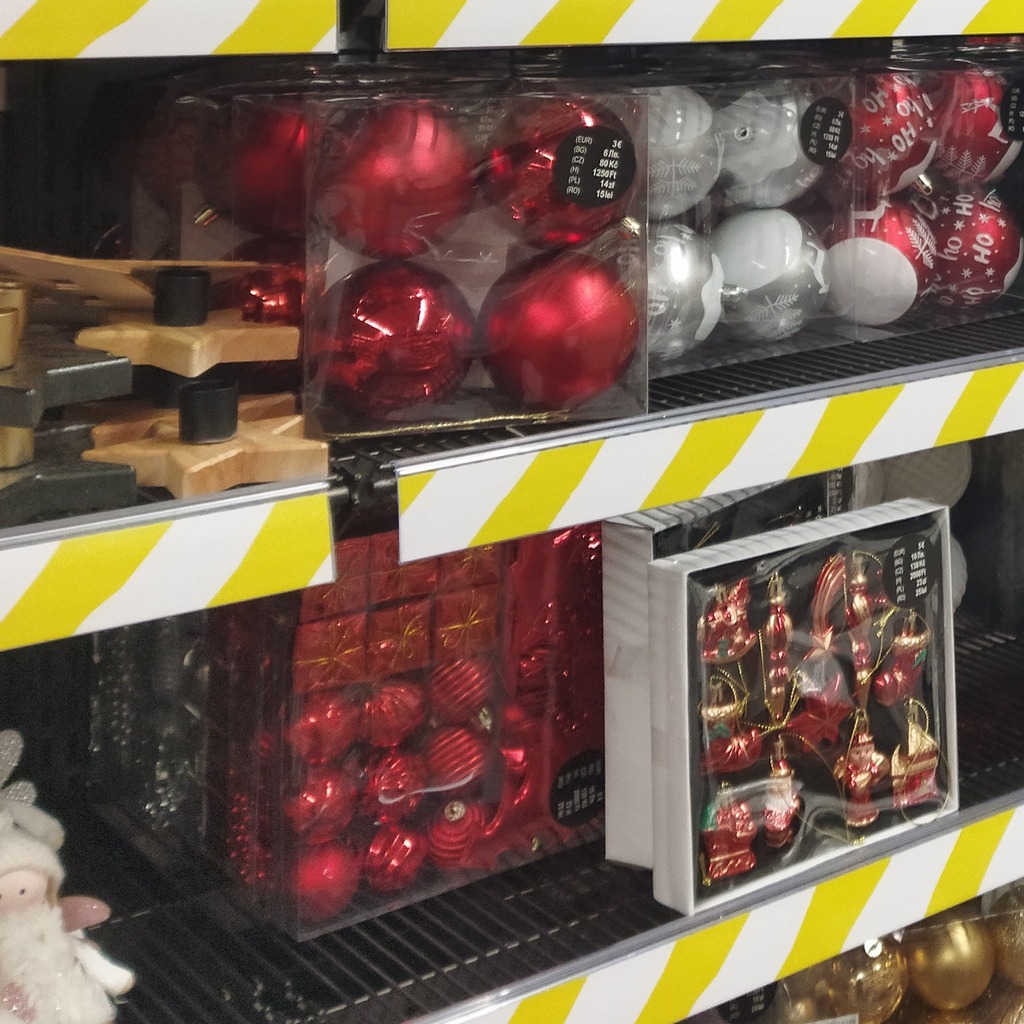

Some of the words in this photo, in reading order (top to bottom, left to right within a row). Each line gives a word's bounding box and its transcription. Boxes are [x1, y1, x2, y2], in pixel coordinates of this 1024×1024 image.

[576, 136, 592, 144] (EUR)
[892, 121, 916, 152] HO
[574, 146, 587, 155] (BG)
[572, 156, 584, 164] (CZ)
[570, 166, 579, 174] (H)
[569, 176, 580, 184] (PL)
[567, 186, 580, 195] (RO)
[953, 194, 974, 216] HO
[936, 236, 962, 261] ho
[972, 233, 994, 264] HO
